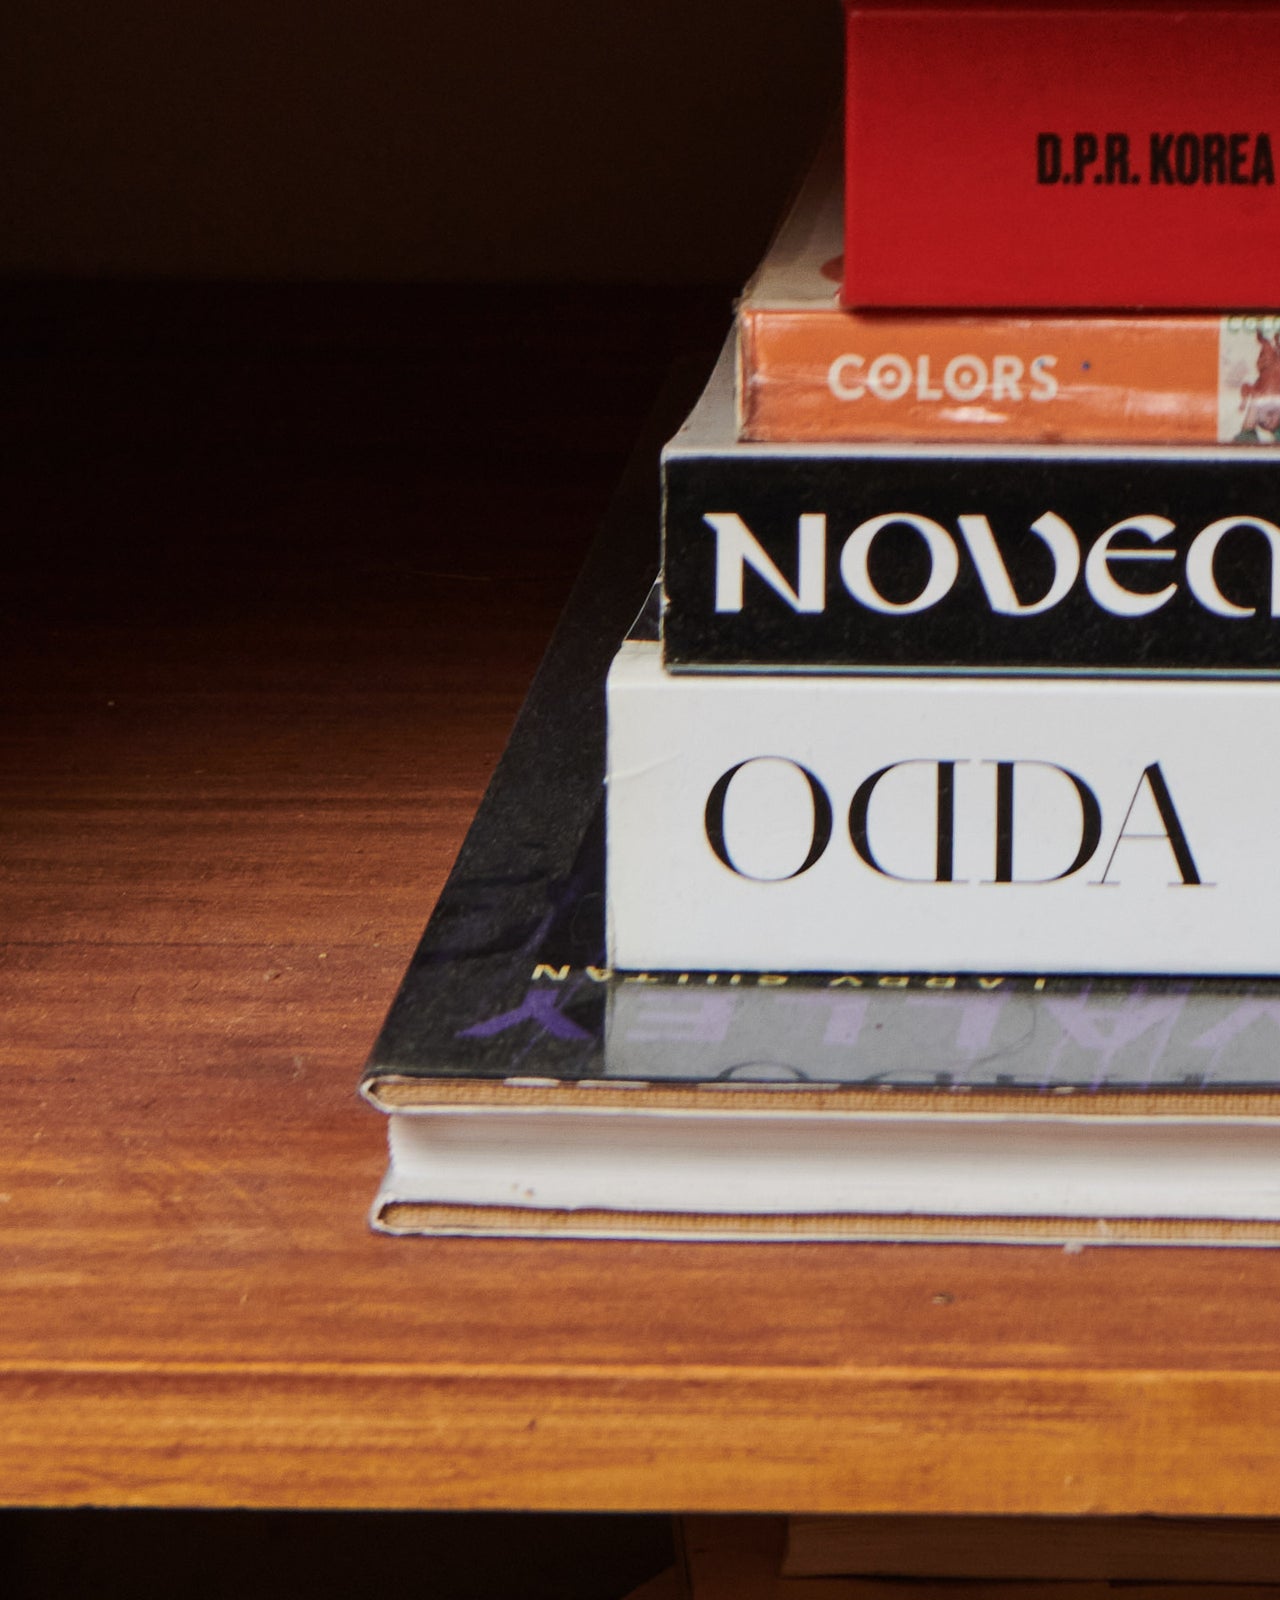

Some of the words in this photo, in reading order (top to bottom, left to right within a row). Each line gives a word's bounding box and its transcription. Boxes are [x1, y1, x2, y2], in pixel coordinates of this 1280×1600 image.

[1036, 132, 1141, 187] D.P.R.
[1148, 132, 1275, 187] KOREA
[825, 354, 1061, 403] COLORS
[703, 755, 1216, 888] ODDA
